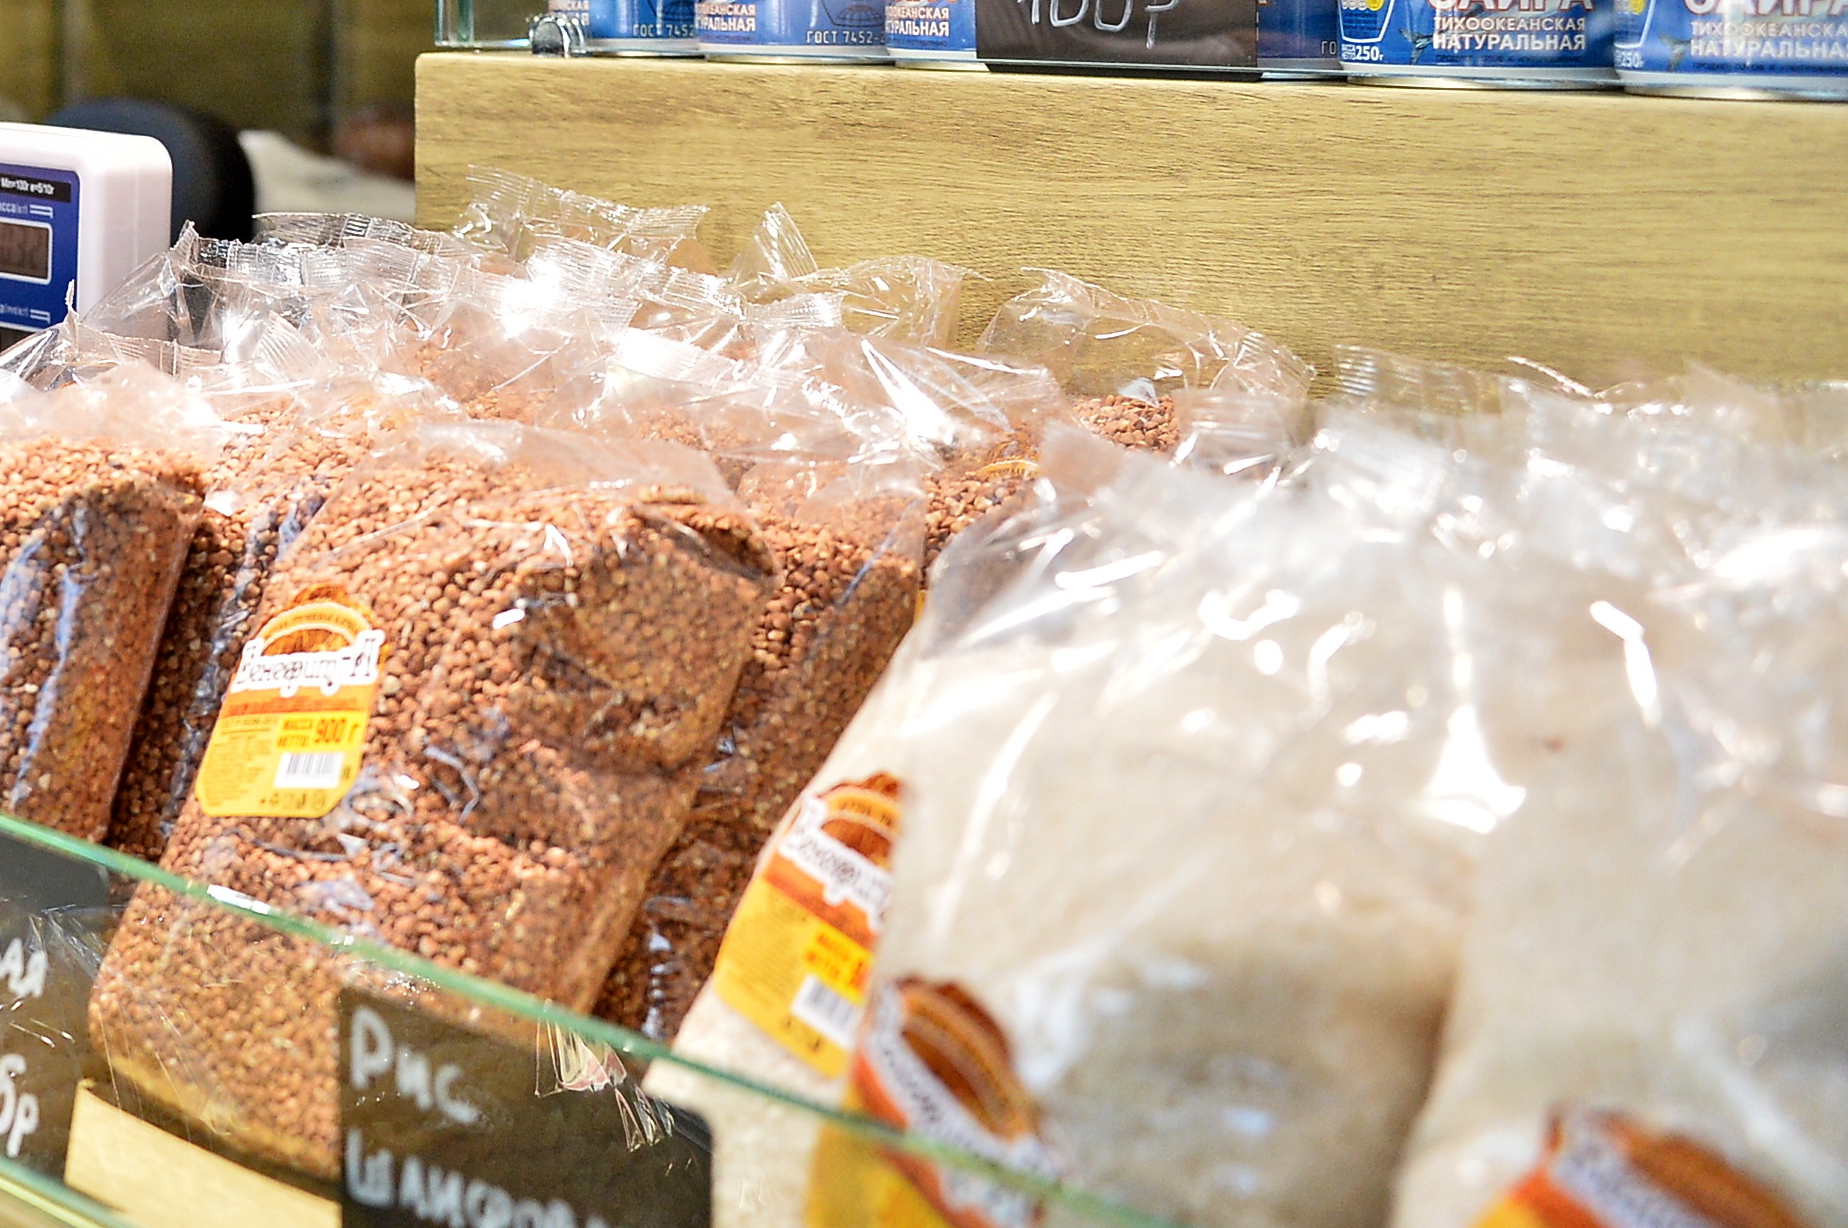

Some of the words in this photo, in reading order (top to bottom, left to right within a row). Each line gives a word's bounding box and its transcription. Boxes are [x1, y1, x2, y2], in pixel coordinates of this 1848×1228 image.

[633, 24, 662, 36] ГОСТ
[1433, 16, 1586, 32] ТИХООКЕАНСКАЯ
[1690, 21, 1848, 38] ТИХООКЕАНСКА
[807, 30, 837, 44] ГОСТ
[1433, 34, 1586, 51] НАТУРАЛЬНАЯ
[1355, 45, 1384, 61] 250г
[1690, 39, 1848, 58] НАТУРАЛЬНА
[315, 717, 347, 744] 900
